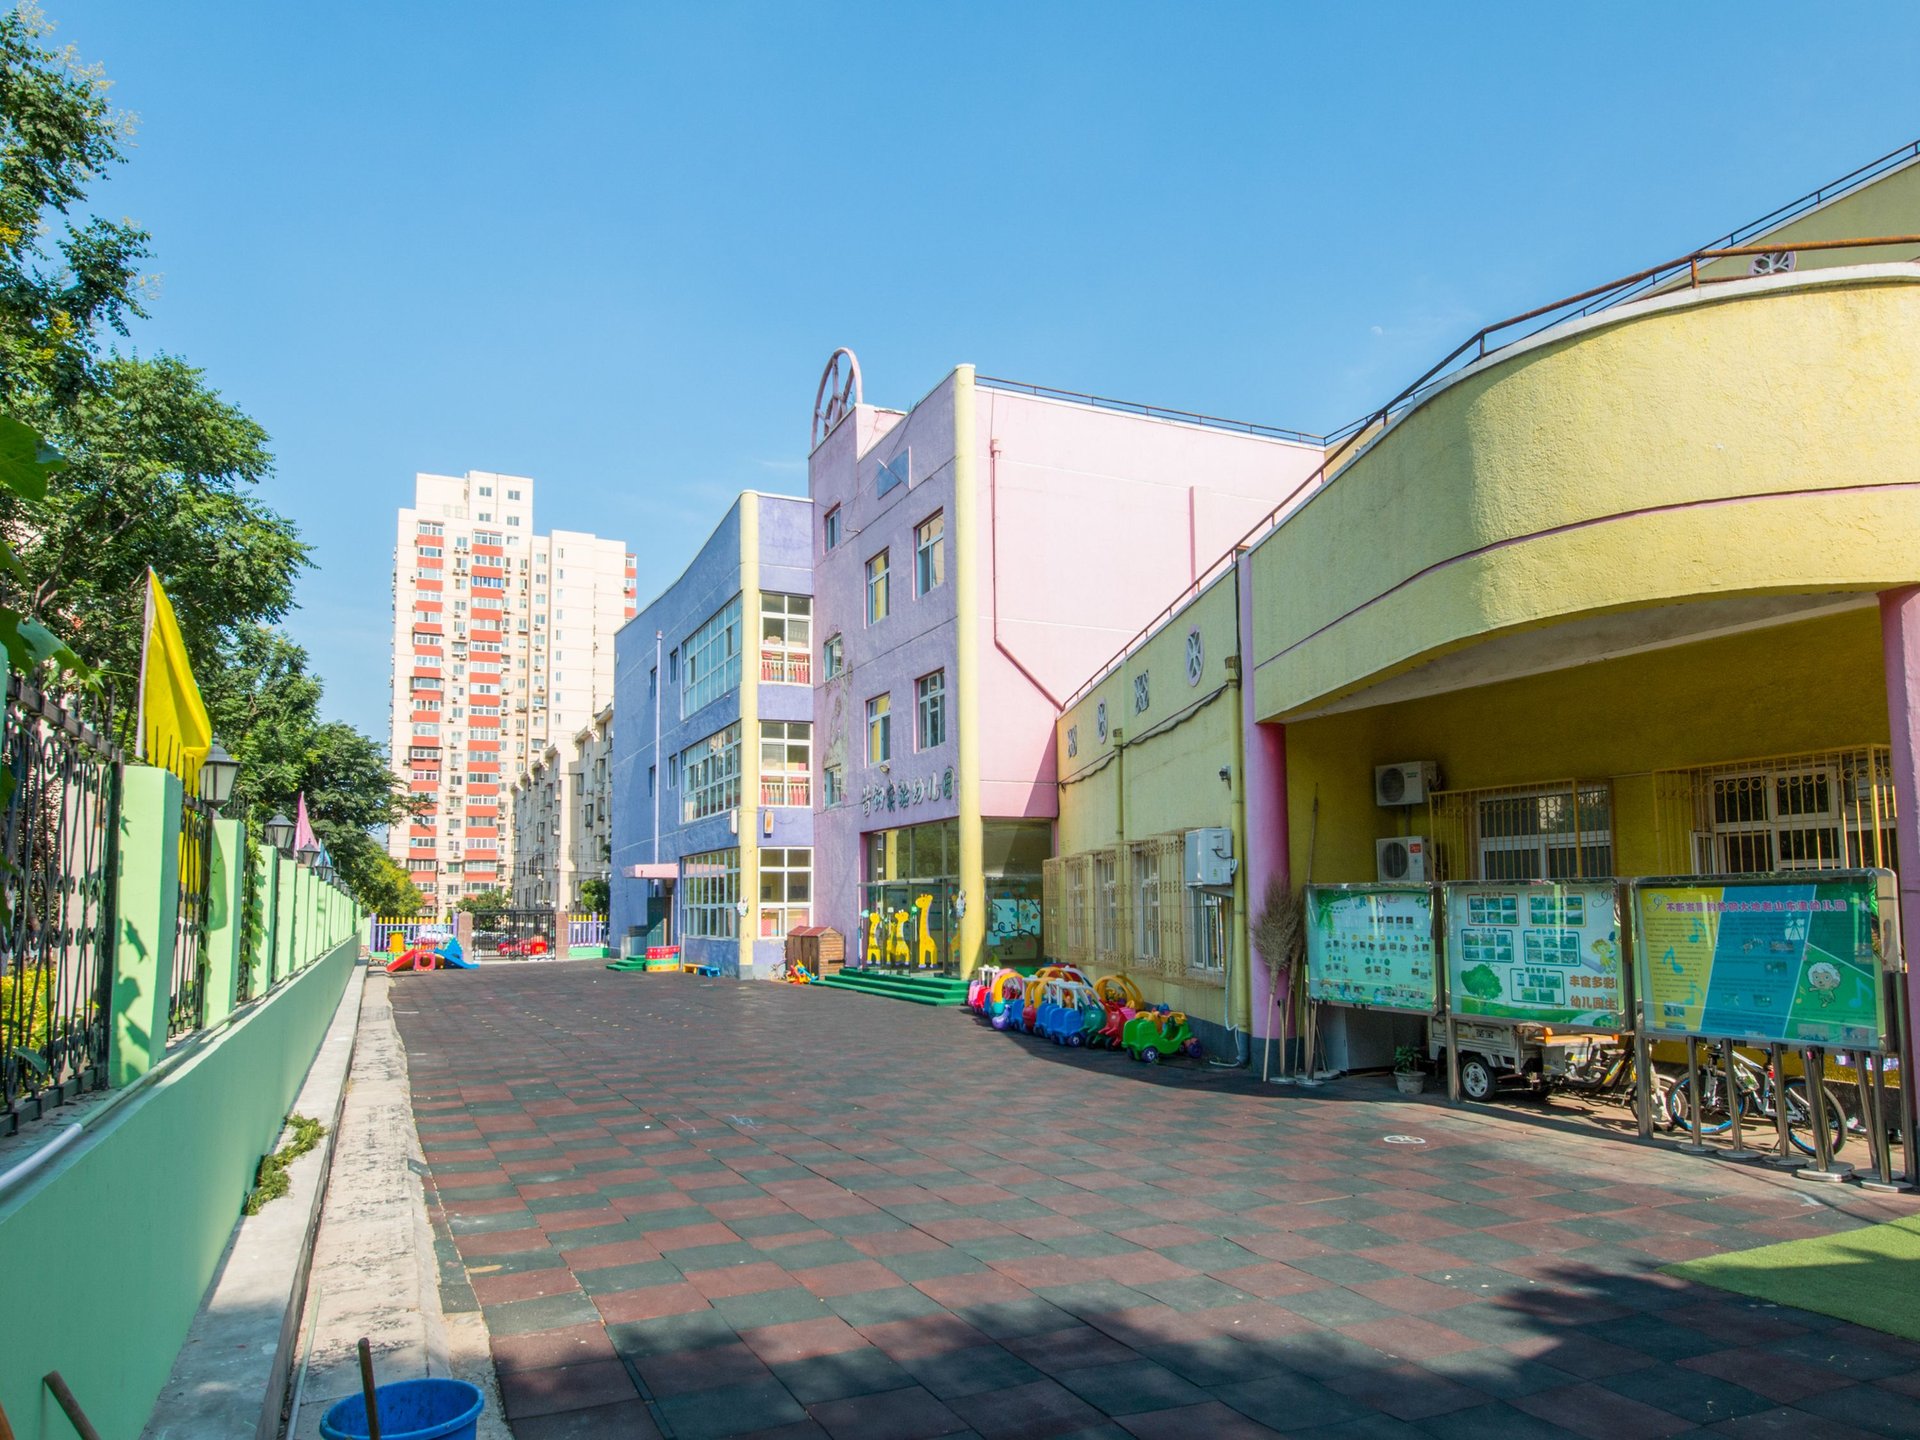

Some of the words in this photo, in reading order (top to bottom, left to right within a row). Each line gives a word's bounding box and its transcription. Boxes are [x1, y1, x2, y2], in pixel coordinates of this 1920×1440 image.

[863, 766, 954, 817] 首钢实验幼儿园
[1569, 975, 1618, 989] 丰富多彩
[1570, 995, 1618, 1010] 幼儿园生
